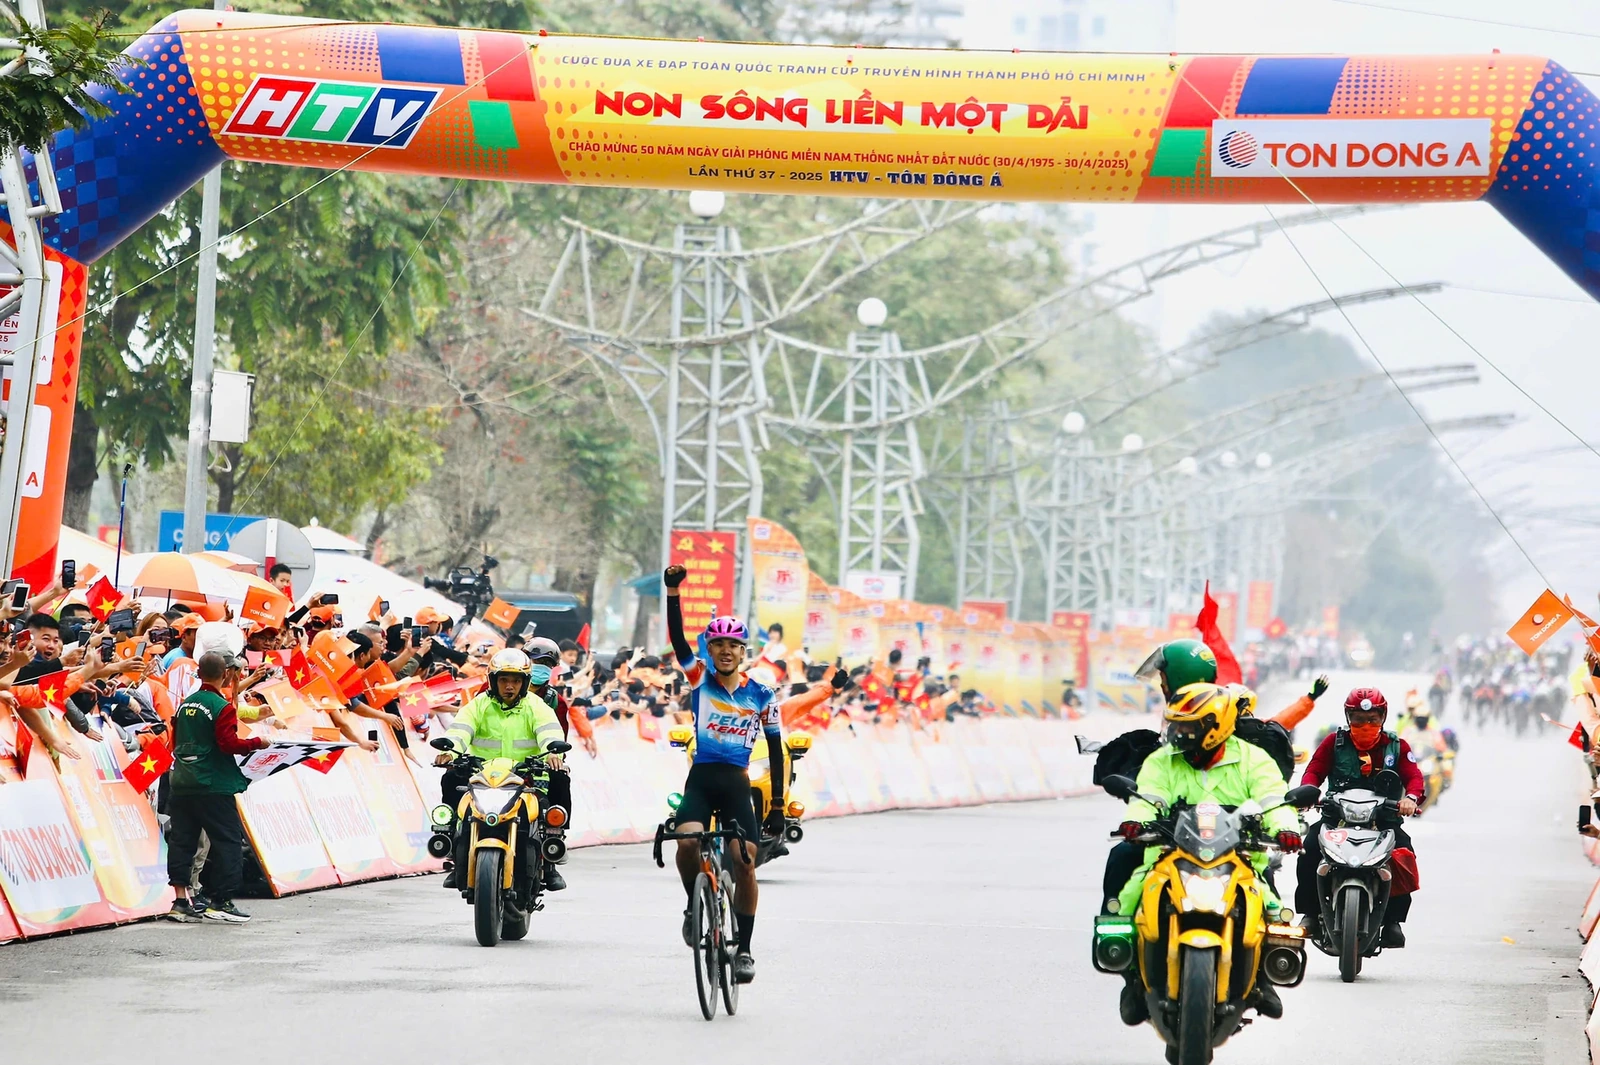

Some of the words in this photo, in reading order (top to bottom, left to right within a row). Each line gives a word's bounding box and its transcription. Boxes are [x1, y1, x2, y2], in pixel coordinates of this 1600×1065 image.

[604, 58, 631, 67] ĐUA
[636, 59, 654, 68] XE
[658, 60, 688, 71] ĐẠP
[778, 64, 827, 74] TRANH
[832, 65, 858, 75] CÚP
[926, 68, 962, 78] HÌNH
[967, 69, 1016, 80] THÀNH
[1079, 70, 1102, 81] CHÍ
[1107, 73, 1146, 82] MINH
[237, 88, 425, 136] HTV
[594, 89, 682, 119] NON
[700, 89, 808, 128] SÔNG
[825, 88, 904, 126] LIỀN
[921, 96, 1008, 134] MỘT
[1027, 96, 1088, 134] DẢI
[569, 140, 600, 152] CHÀO
[604, 142, 638, 154] MỪNG
[641, 145, 654, 155] 50
[658, 144, 684, 156] NĂM
[687, 145, 719, 158] NGÀY
[722, 146, 745, 159] GIẢI
[748, 148, 788, 160] PHÓNG
[792, 148, 822, 162] MIỀN
[854, 150, 894, 164] THỐNG
[897, 152, 930, 164] NHẤT
[932, 152, 956, 165] ĐẤT
[958, 154, 990, 166] NƯỚC
[994, 156, 1054, 169] (30/4/1975
[1064, 158, 1129, 170] 30/4/2025)
[1263, 142, 1337, 168] TON
[1346, 142, 1448, 168] DONG
[1455, 142, 1482, 167] A
[689, 164, 719, 177] LẦN
[724, 167, 756, 179] THỨ
[759, 170, 776, 179] 37
[789, 172, 823, 181] 2025
[829, 170, 870, 183] HTV
[887, 170, 926, 185] TÔN
[933, 171, 984, 186] ĐÔNG
[990, 172, 1003, 188] Á
